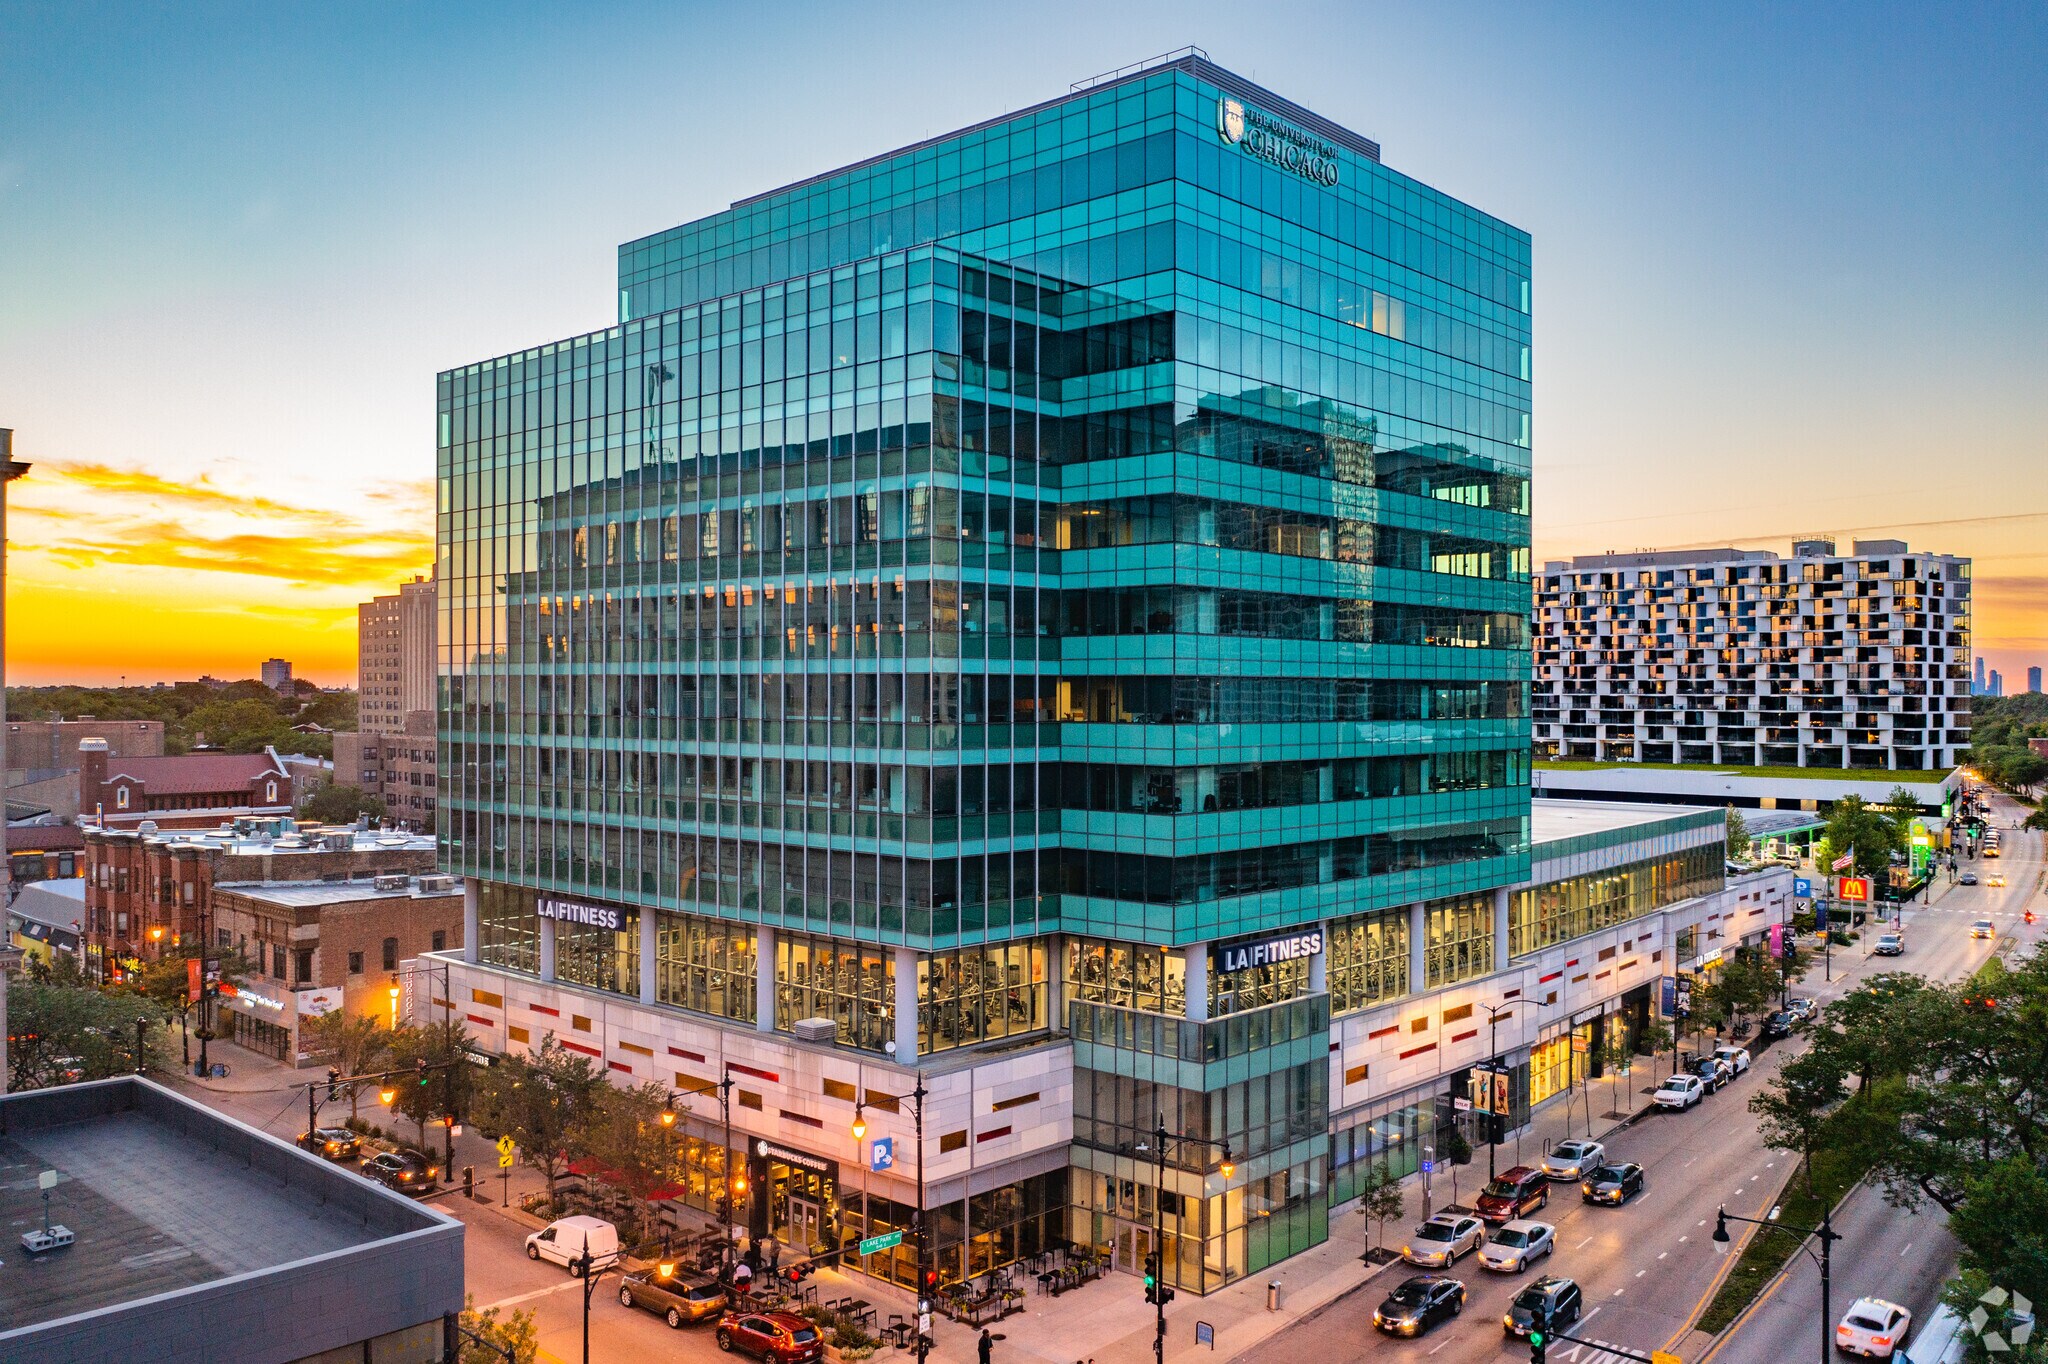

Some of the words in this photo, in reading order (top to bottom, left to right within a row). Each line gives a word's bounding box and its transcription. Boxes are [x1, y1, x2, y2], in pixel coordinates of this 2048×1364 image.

[1250, 109, 1268, 127] THE
[1272, 120, 1325, 153] UNIVERSITY
[1327, 146, 1339, 158] OF
[1249, 128, 1339, 187] CHICAGO
[538, 899, 554, 918] LA
[559, 902, 617, 929] FITNESS
[1225, 948, 1249, 971] LA
[1254, 933, 1321, 966] FITNESS
[767, 1147, 802, 1164] STARBUCKS
[802, 1158, 828, 1171] COFFEE
[874, 1144, 887, 1164] P
[866, 1239, 879, 1247] LAKE
[880, 1235, 892, 1243] PARK
